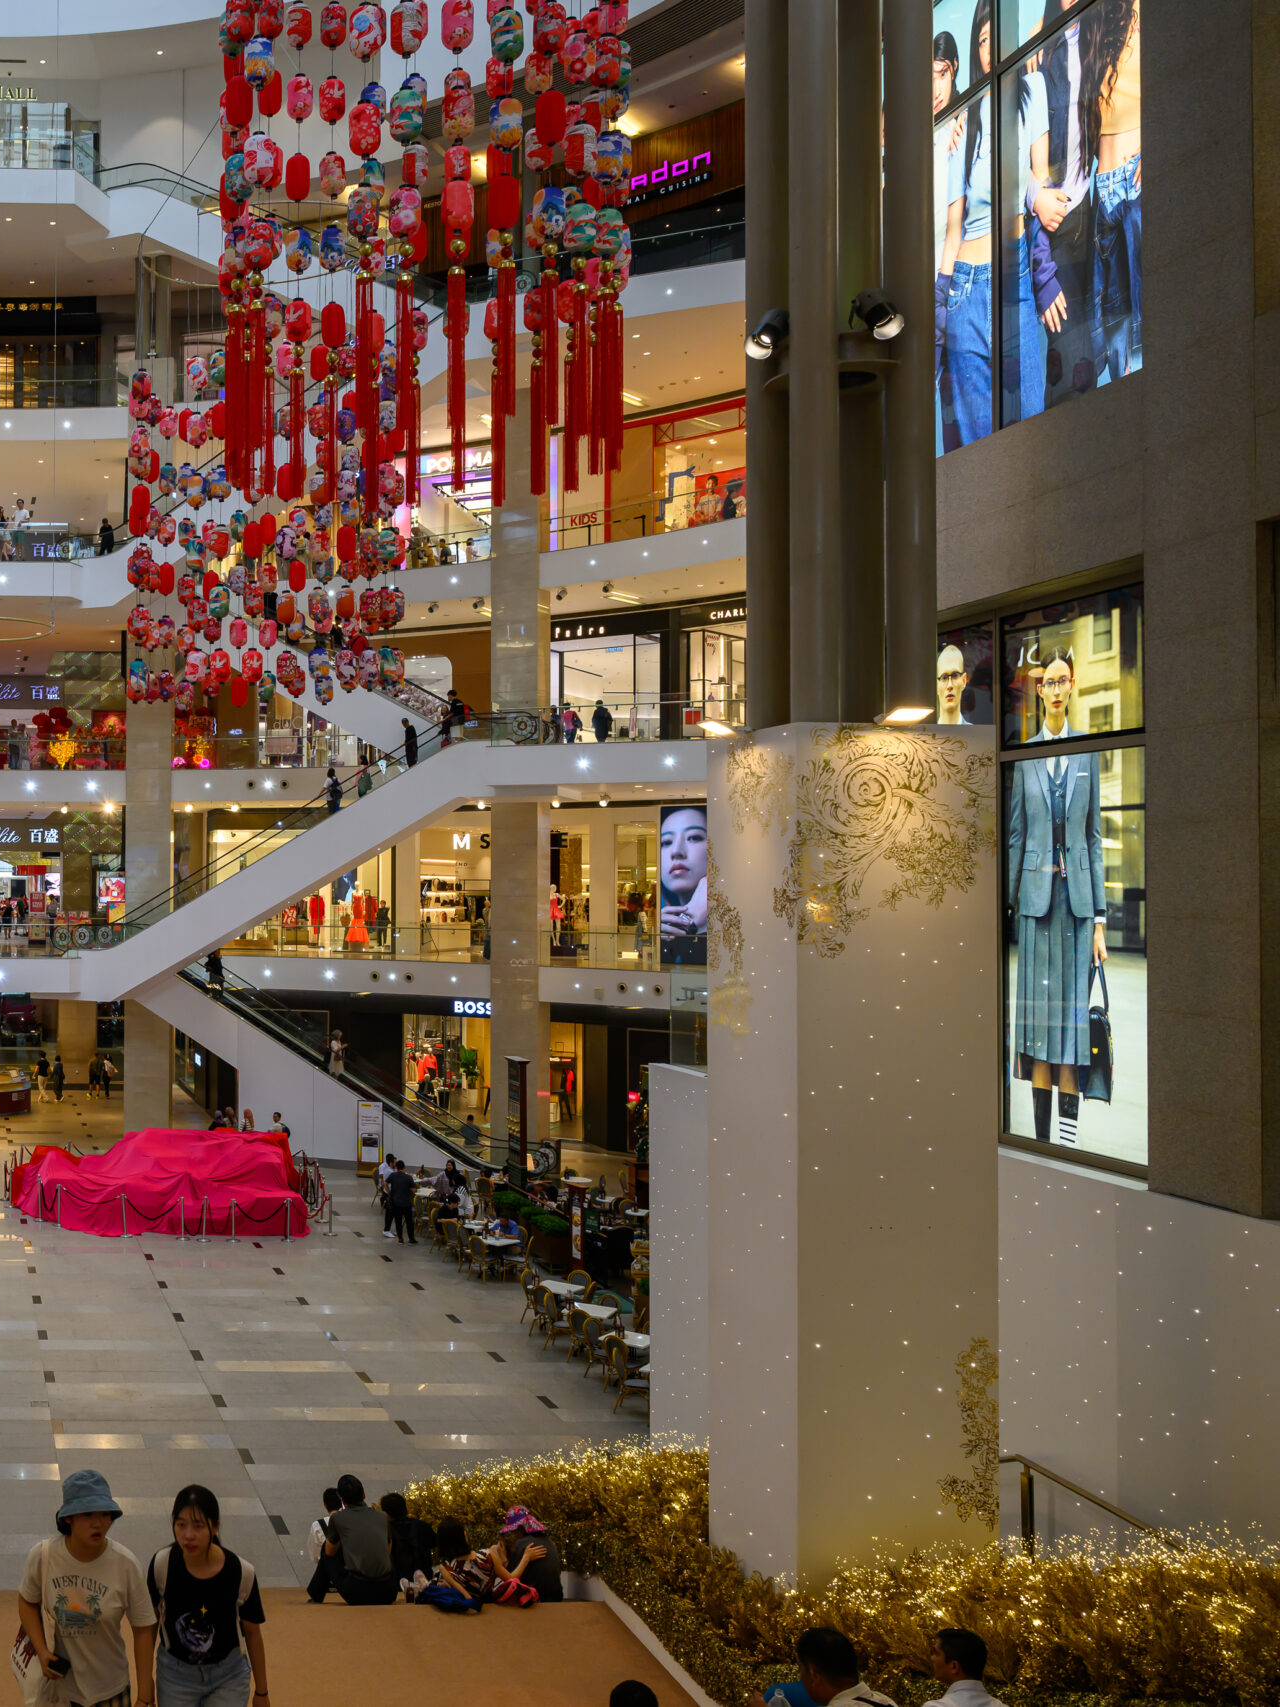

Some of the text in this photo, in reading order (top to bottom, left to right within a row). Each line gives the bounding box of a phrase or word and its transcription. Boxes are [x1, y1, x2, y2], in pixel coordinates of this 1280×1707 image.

[659, 172, 709, 195] CUISINE
[570, 512, 598, 527] KIDS
[709, 607, 748, 620] CHARL
[554, 624, 605, 639] Pedro
[30, 685, 61, 700] 百盛
[28, 828, 60, 844] 百盛
[453, 1000, 492, 1016] BOSS
[52, 1575, 80, 1590] WEST
